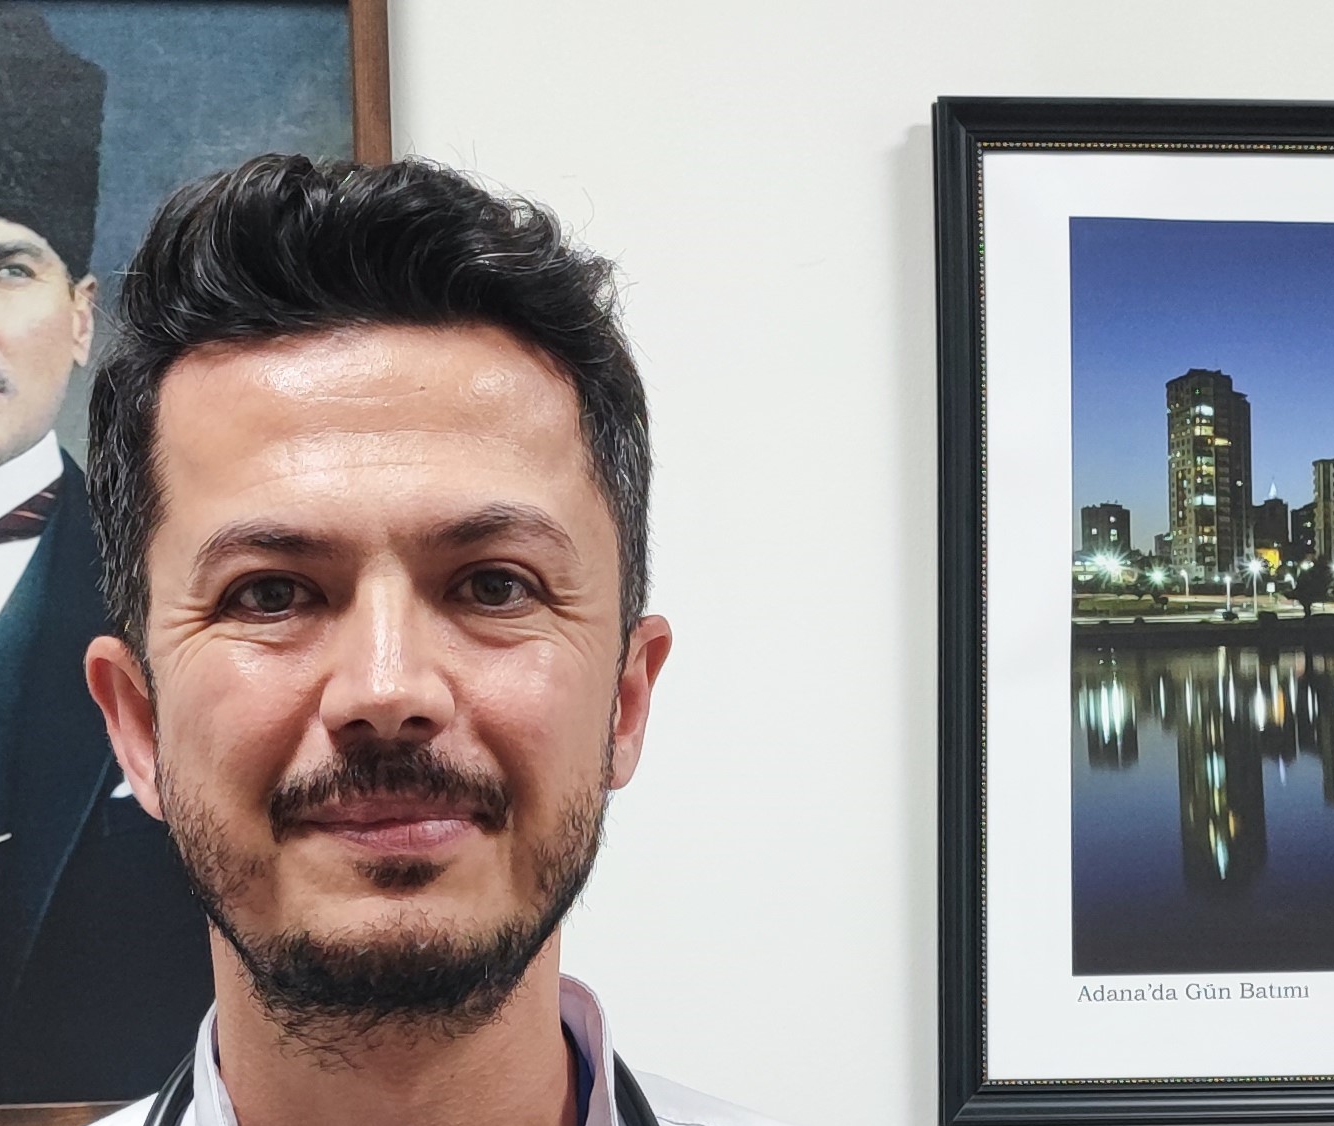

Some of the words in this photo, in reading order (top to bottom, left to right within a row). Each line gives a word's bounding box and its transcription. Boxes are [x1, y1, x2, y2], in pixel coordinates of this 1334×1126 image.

[1077, 983, 1178, 1003] Adana'da
[1185, 982, 1232, 1000] Gün
[1239, 982, 1310, 999] Batımı
